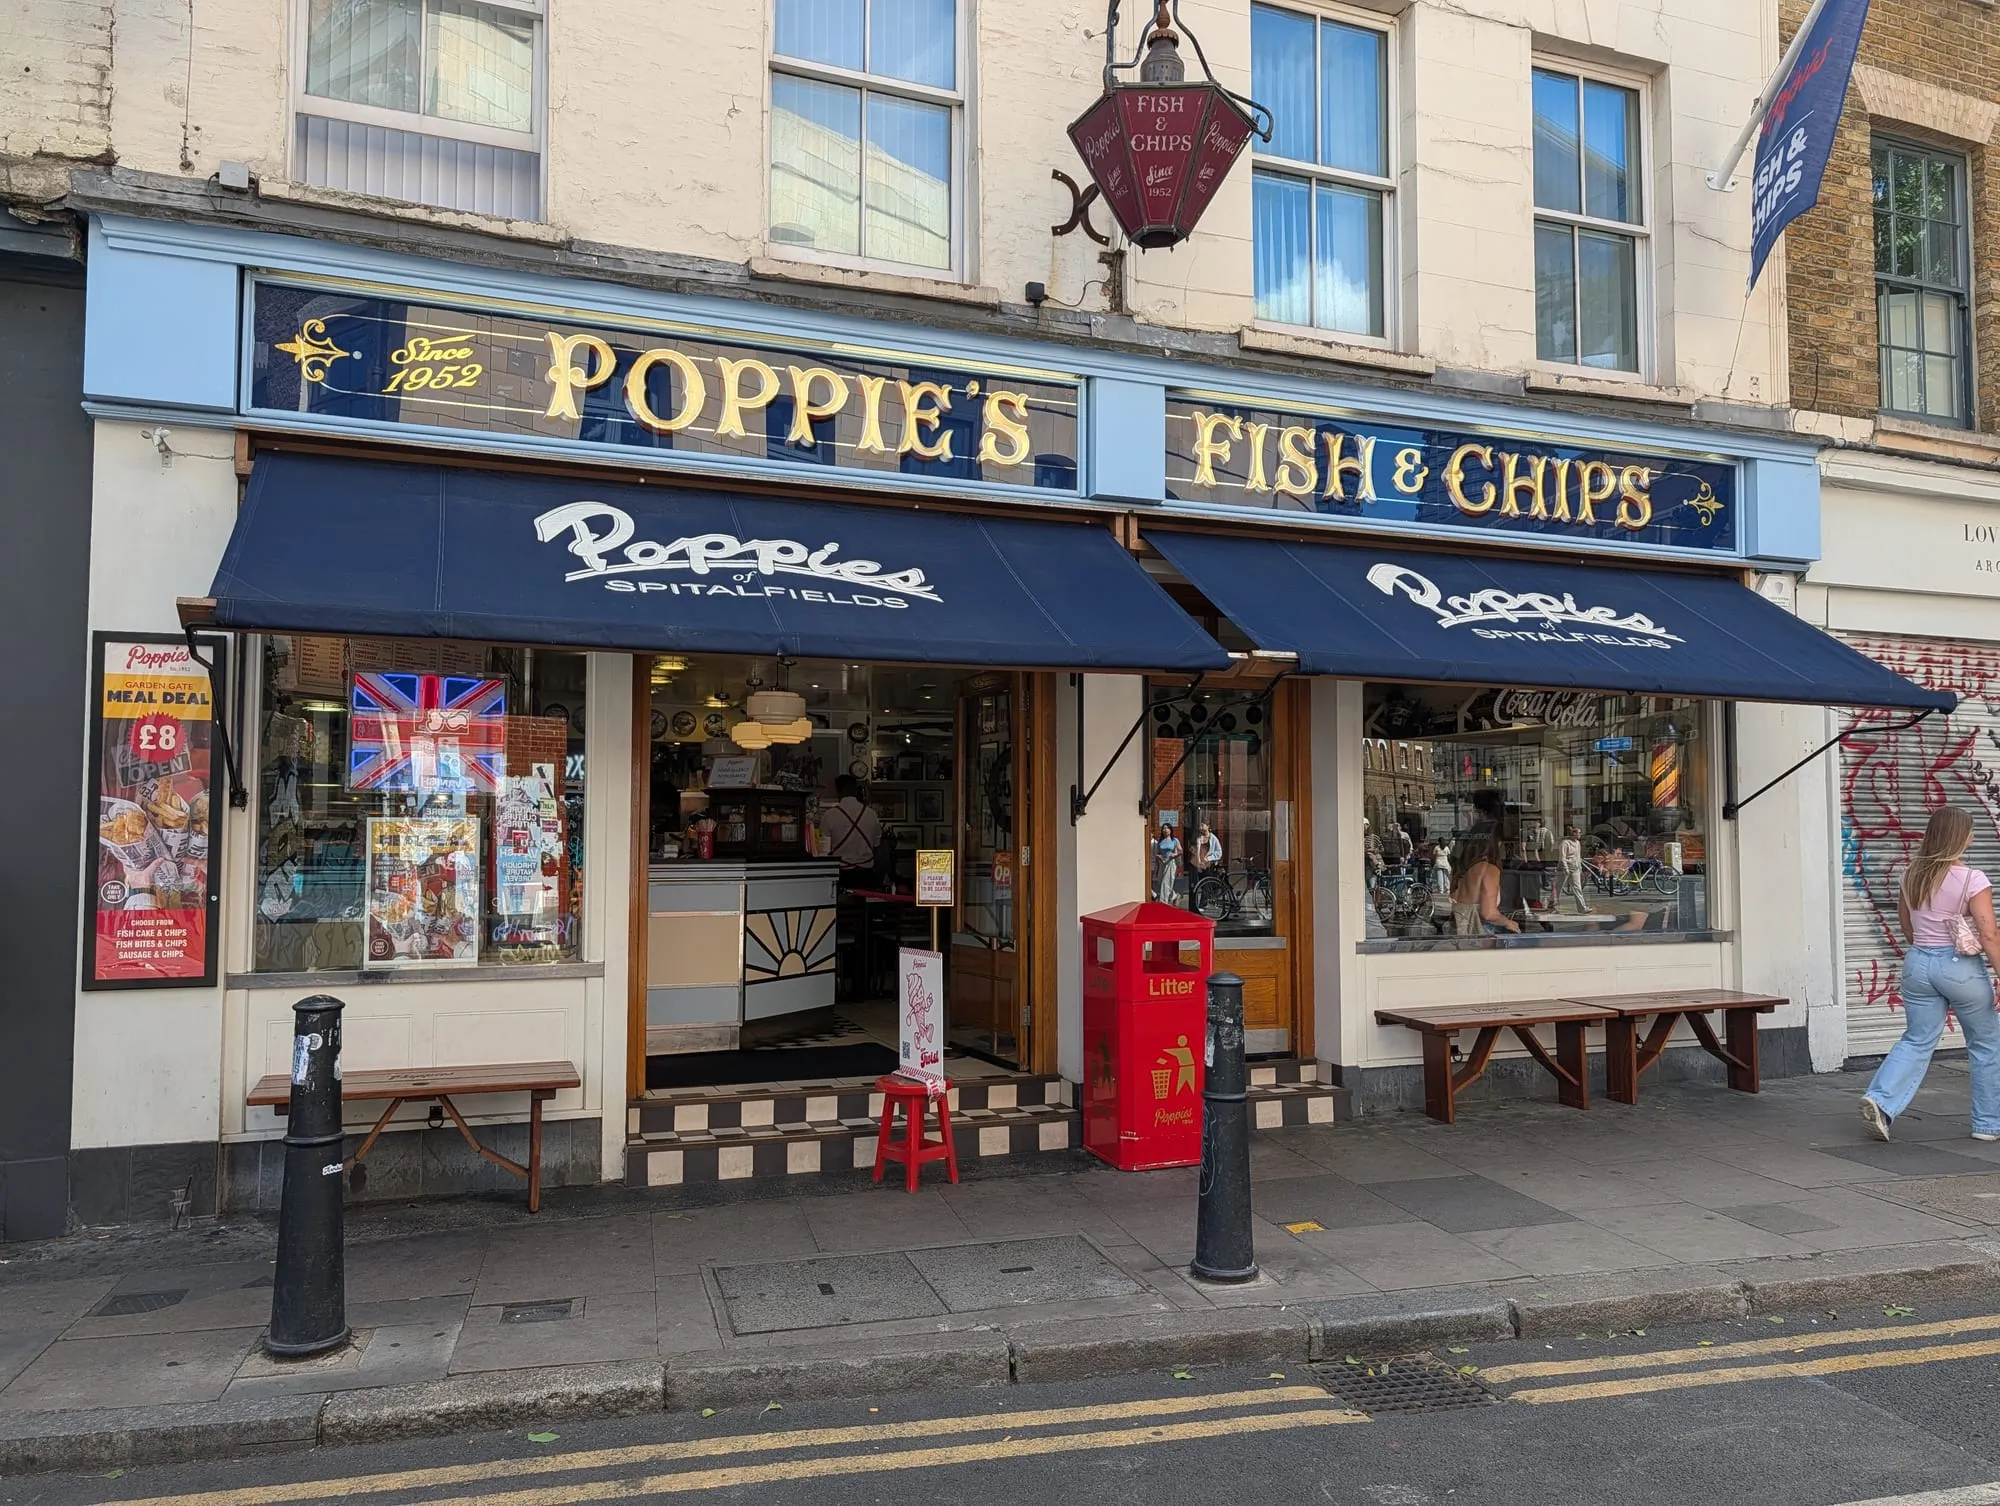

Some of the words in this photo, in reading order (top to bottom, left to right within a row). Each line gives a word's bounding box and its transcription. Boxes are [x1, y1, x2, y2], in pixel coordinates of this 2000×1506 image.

[1137, 95, 1185, 113] FISH
[1155, 116, 1168, 132] &
[1085, 117, 1121, 169] Poppies
[1130, 134, 1192, 151] CHIPS
[1203, 121, 1239, 156] Poppies
[1146, 165, 1173, 186] Since
[1752, 146, 1784, 206] ISH
[1787, 127, 1808, 162] &
[1149, 188, 1172, 197] 1952
[391, 334, 475, 364] Since
[382, 364, 483, 393] 1952
[543, 331, 1031, 466] POPPIE'S
[1192, 411, 1377, 504] FISH
[1392, 448, 1429, 494] &
[1442, 443, 1652, 531] CHIPS
[534, 500, 940, 596] Poppies
[733, 570, 757, 584] of
[604, 579, 910, 610] SPITALFIELDS
[1366, 563, 1668, 635] Poppies
[1472, 628, 1672, 649] SPITALFIELDS
[126, 645, 190, 669] Poppies
[107, 690, 157, 703] MEAL
[162, 692, 210, 705] DEAL
[125, 682, 167, 690] GARDEN
[169, 682, 193, 690] GATE
[139, 724, 176, 750] £8
[129, 757, 184, 782] OPEN
[116, 940, 133, 948] FISH
[135, 940, 156, 948] BITES
[165, 939, 188, 947] CHIPS
[117, 929, 134, 937] FISH
[136, 929, 156, 937] CAKE
[157, 929, 163, 937] &
[164, 928, 187, 937] CHIPS
[118, 951, 152, 959] SAUSAGE
[153, 950, 160, 958] &
[161, 950, 184, 958] CHIPS
[1150, 978, 1195, 996] Litter
[1154, 1105, 1193, 1128] Poppies
